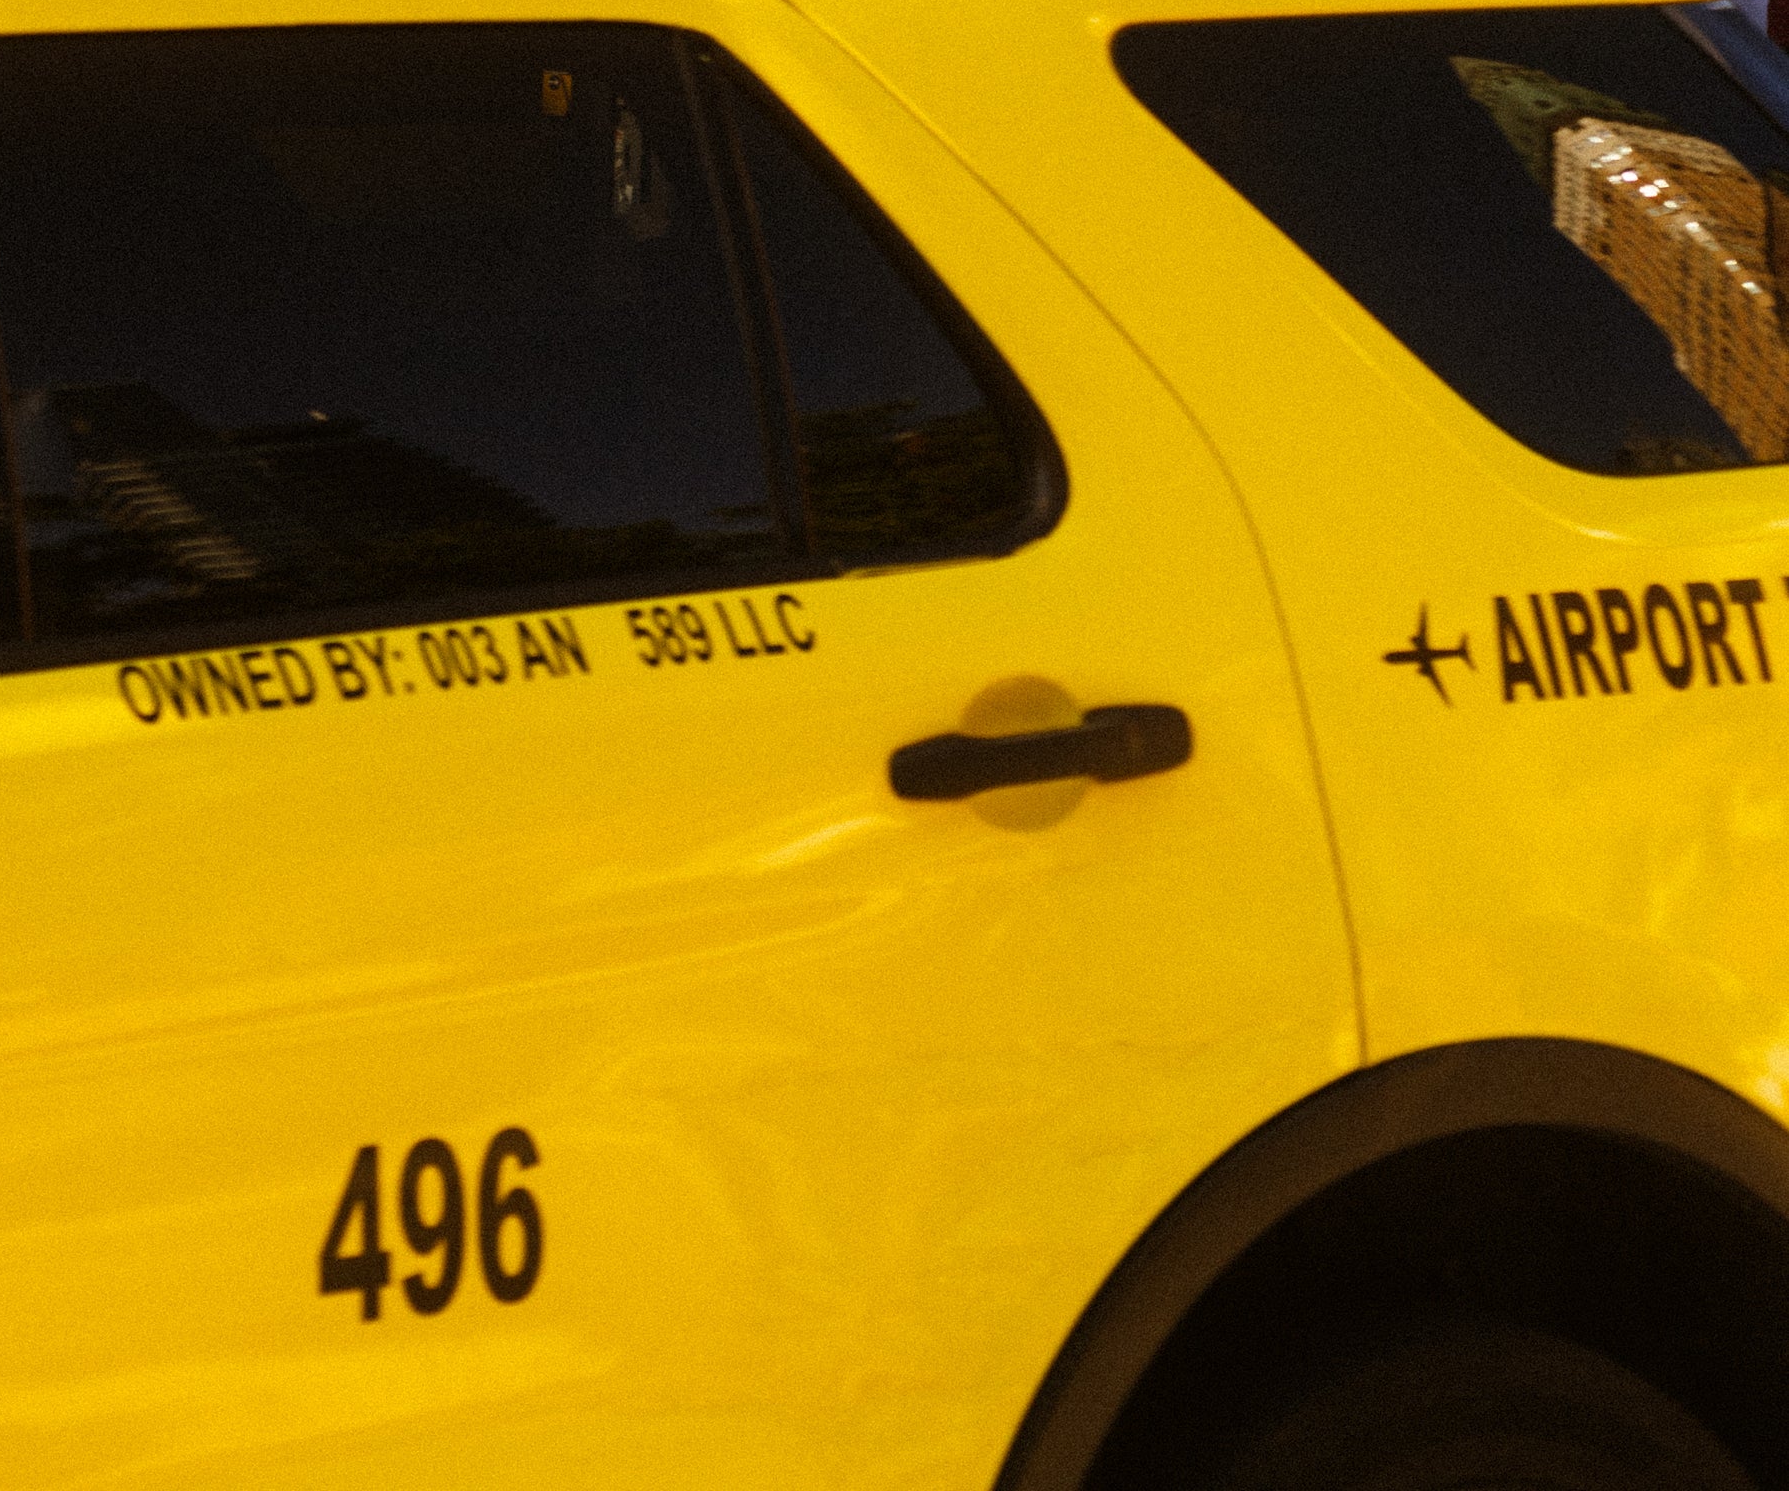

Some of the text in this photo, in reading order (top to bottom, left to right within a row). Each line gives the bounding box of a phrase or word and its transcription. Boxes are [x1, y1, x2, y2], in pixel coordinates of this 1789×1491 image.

[116, 593, 817, 725] OWNED BY: 003 AN 589 LLC
[1492, 578, 1773, 704] AIRPORT
[319, 1126, 545, 1323] 496
